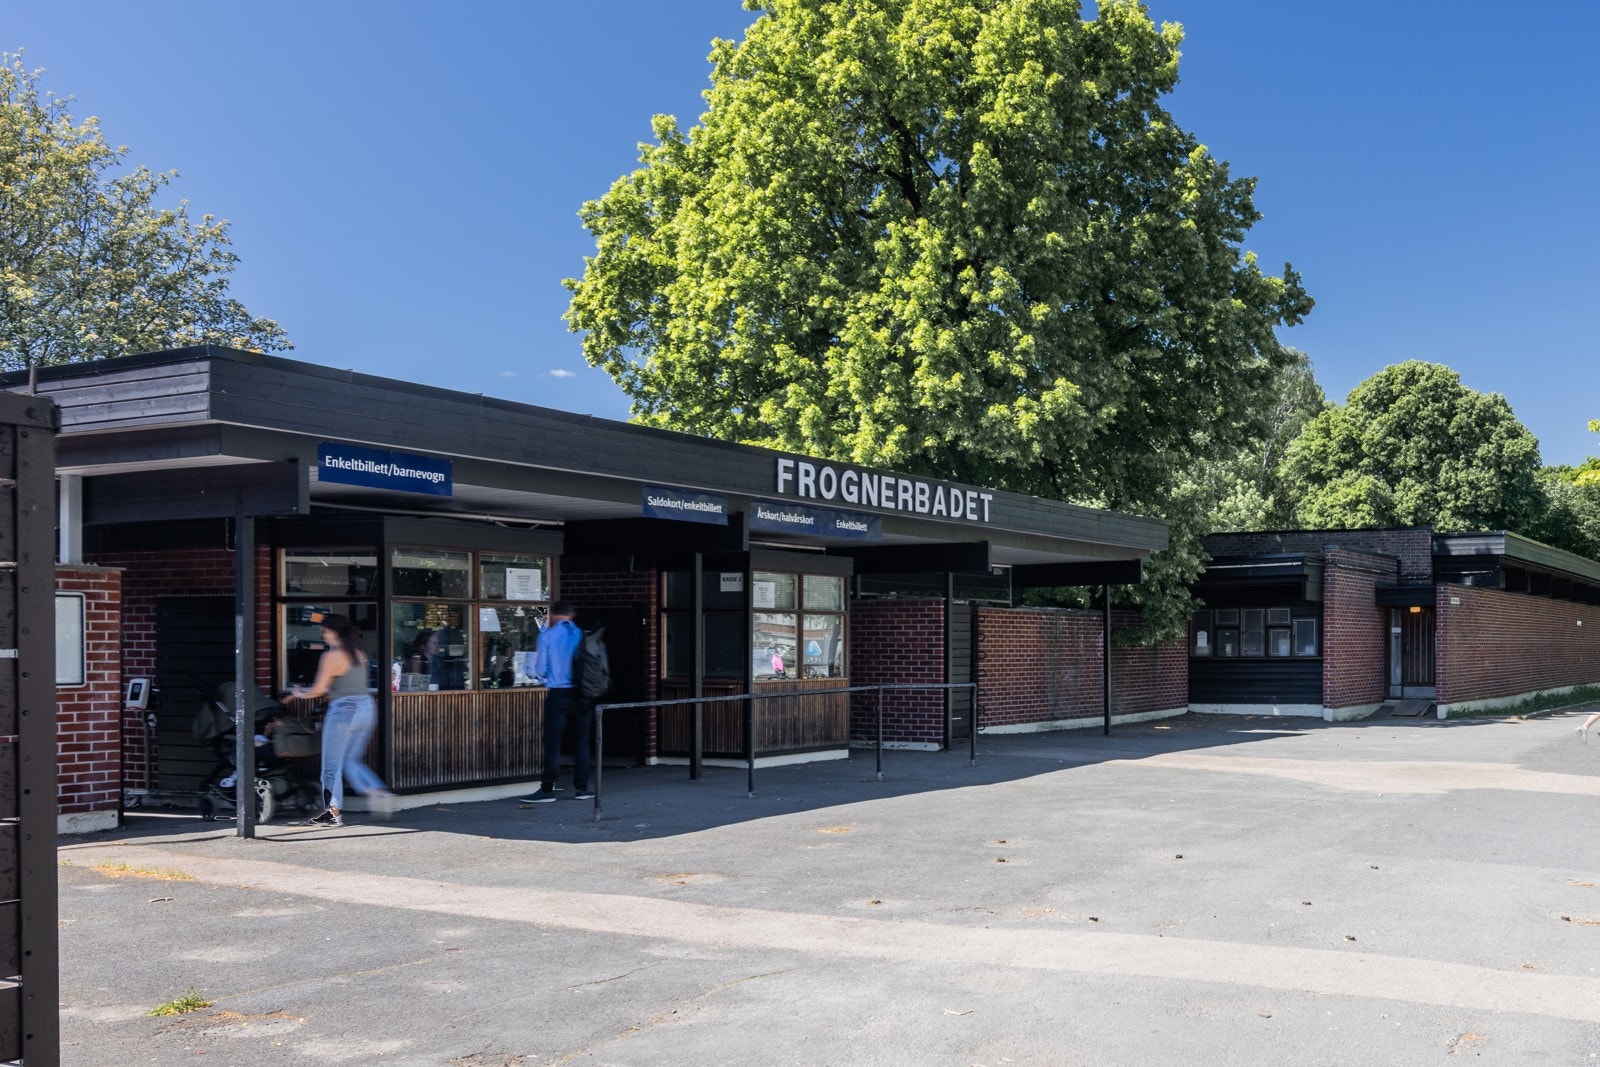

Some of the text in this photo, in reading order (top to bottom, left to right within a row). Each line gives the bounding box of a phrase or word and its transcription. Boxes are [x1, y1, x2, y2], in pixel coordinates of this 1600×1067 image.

[325, 455, 445, 483] Enkeltbillett/barnevogn
[777, 458, 993, 522] FROGNERBADET
[647, 495, 723, 514] Saldokort/enkeltbillett
[757, 506, 814, 525] Årskort/halvårskort
[836, 519, 868, 532] Enkeltbillett
